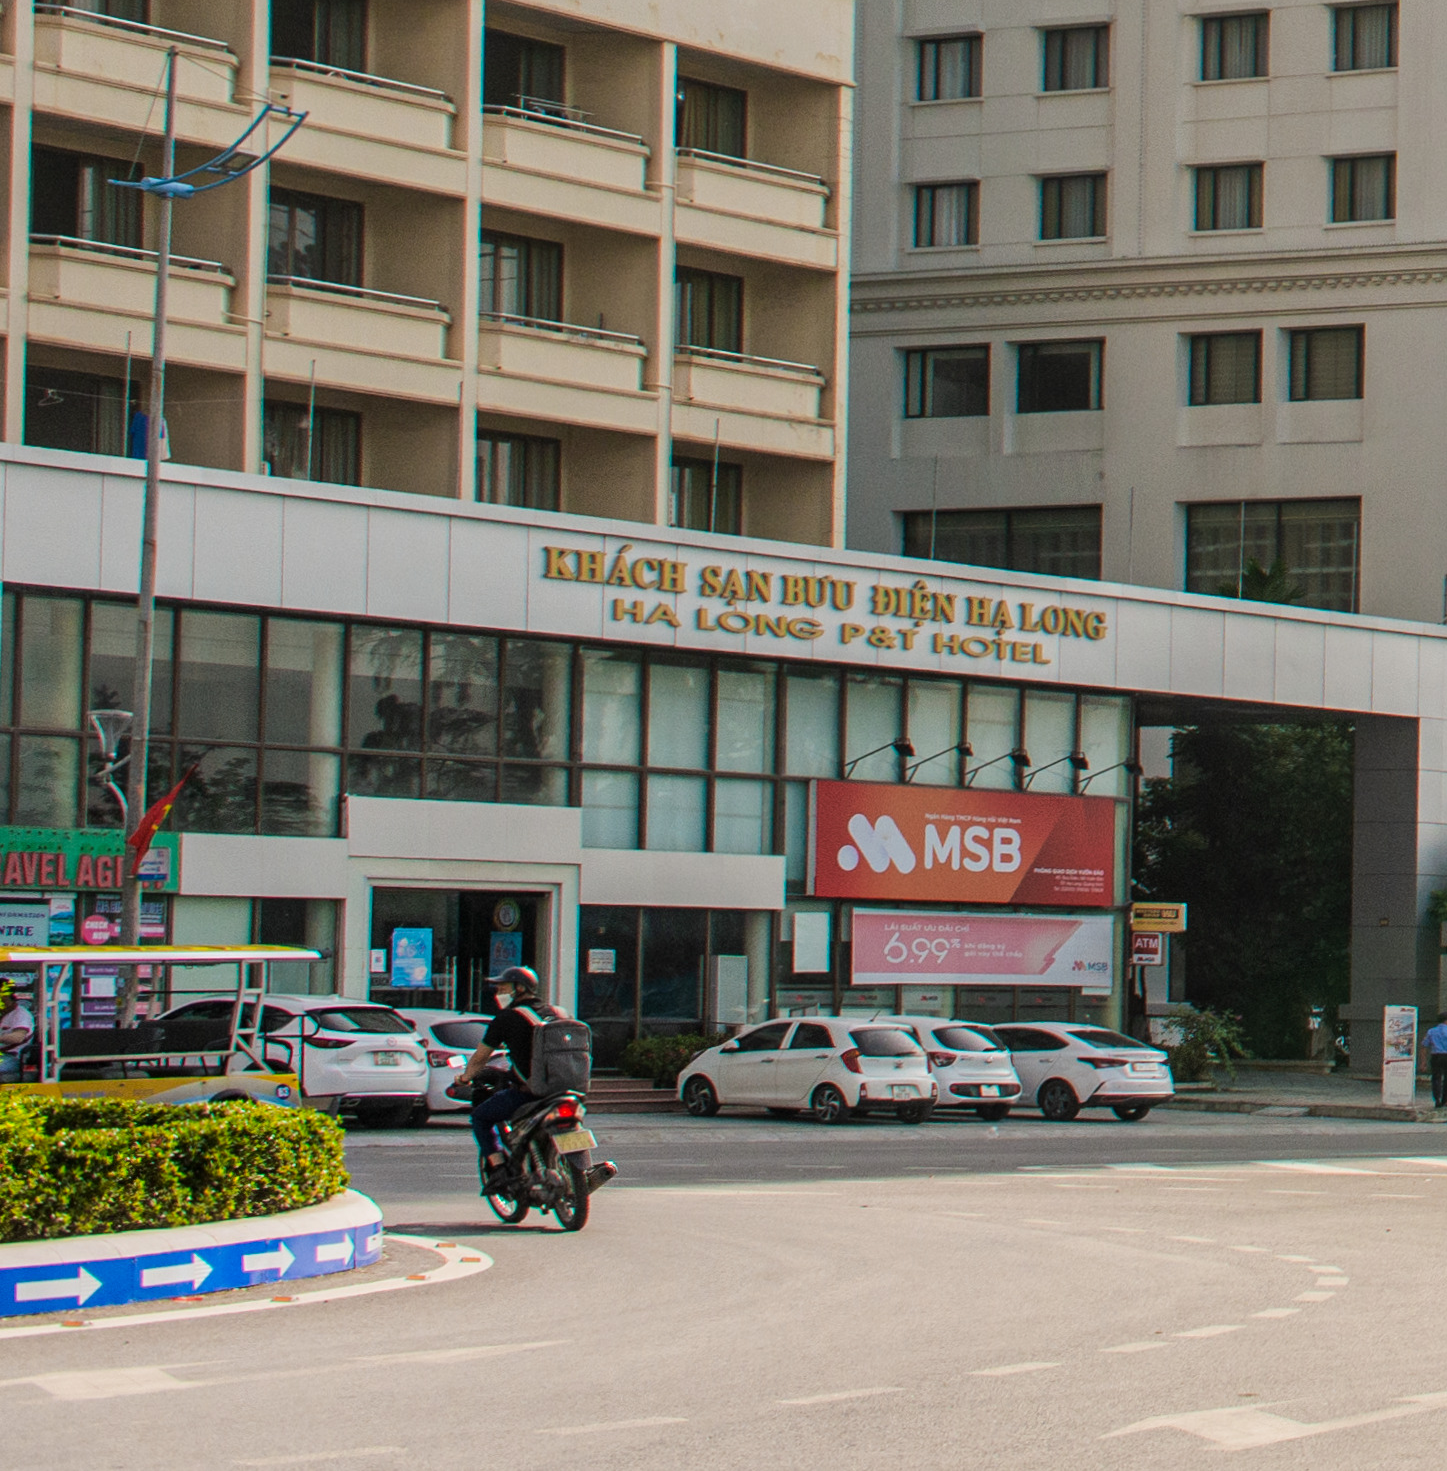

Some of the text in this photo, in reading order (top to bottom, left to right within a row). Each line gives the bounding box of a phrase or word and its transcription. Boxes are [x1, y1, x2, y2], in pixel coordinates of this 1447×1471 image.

[543, 544, 1108, 641] KHÁCH SẠN BƯU ĐIỆN HẠ LONG
[612, 598, 1051, 665] HA LONG P&T HOTEL
[0, 852, 71, 886] AVEL
[924, 823, 1022, 873] MSB
[0, 925, 34, 937] NTRE
[1135, 937, 1158, 948] ATM
